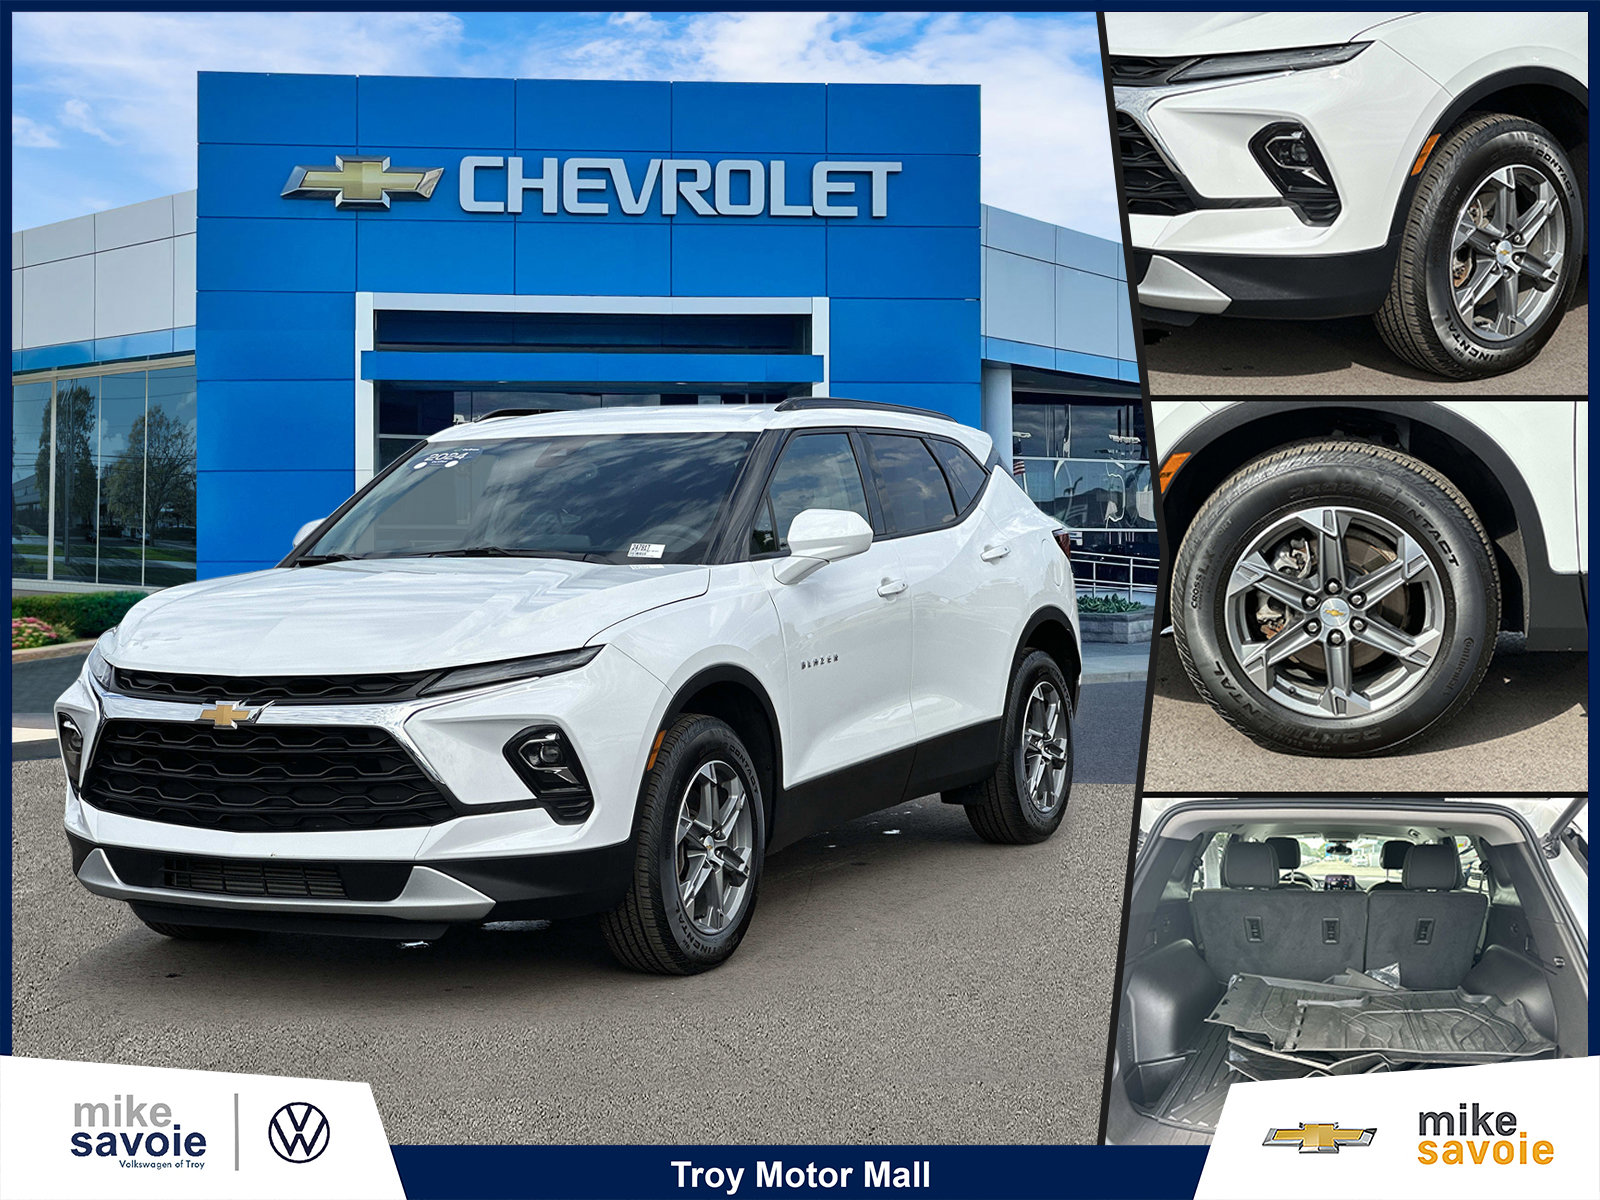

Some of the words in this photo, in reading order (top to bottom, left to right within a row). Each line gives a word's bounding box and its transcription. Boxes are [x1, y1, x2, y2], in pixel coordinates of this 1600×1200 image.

[458, 155, 903, 217] CHEVROLET
[424, 452, 469, 461] 2024
[801, 654, 839, 670] BLAZER
